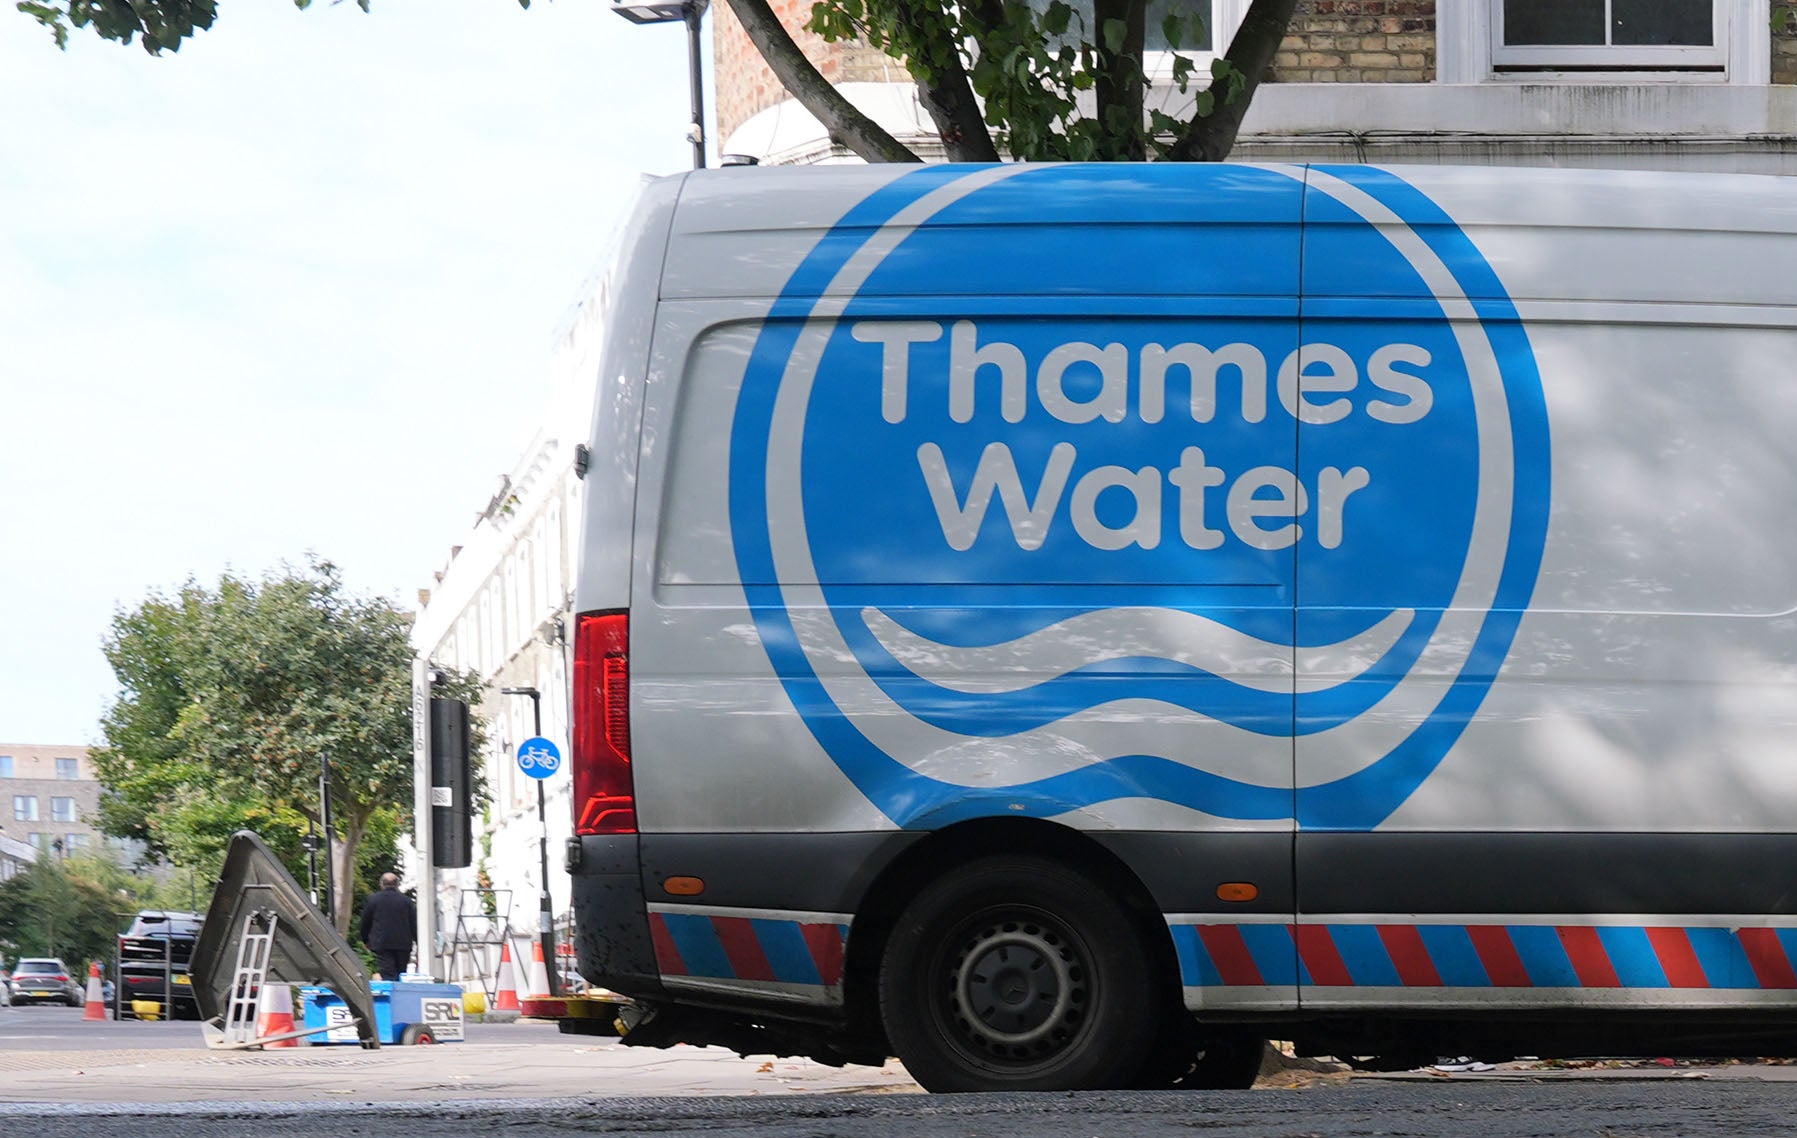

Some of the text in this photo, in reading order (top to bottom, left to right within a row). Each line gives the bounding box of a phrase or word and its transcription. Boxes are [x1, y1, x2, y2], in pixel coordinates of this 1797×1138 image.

[852, 320, 1434, 424] Thames
[916, 442, 1370, 551] Water
[425, 1002, 460, 1020] SRL
